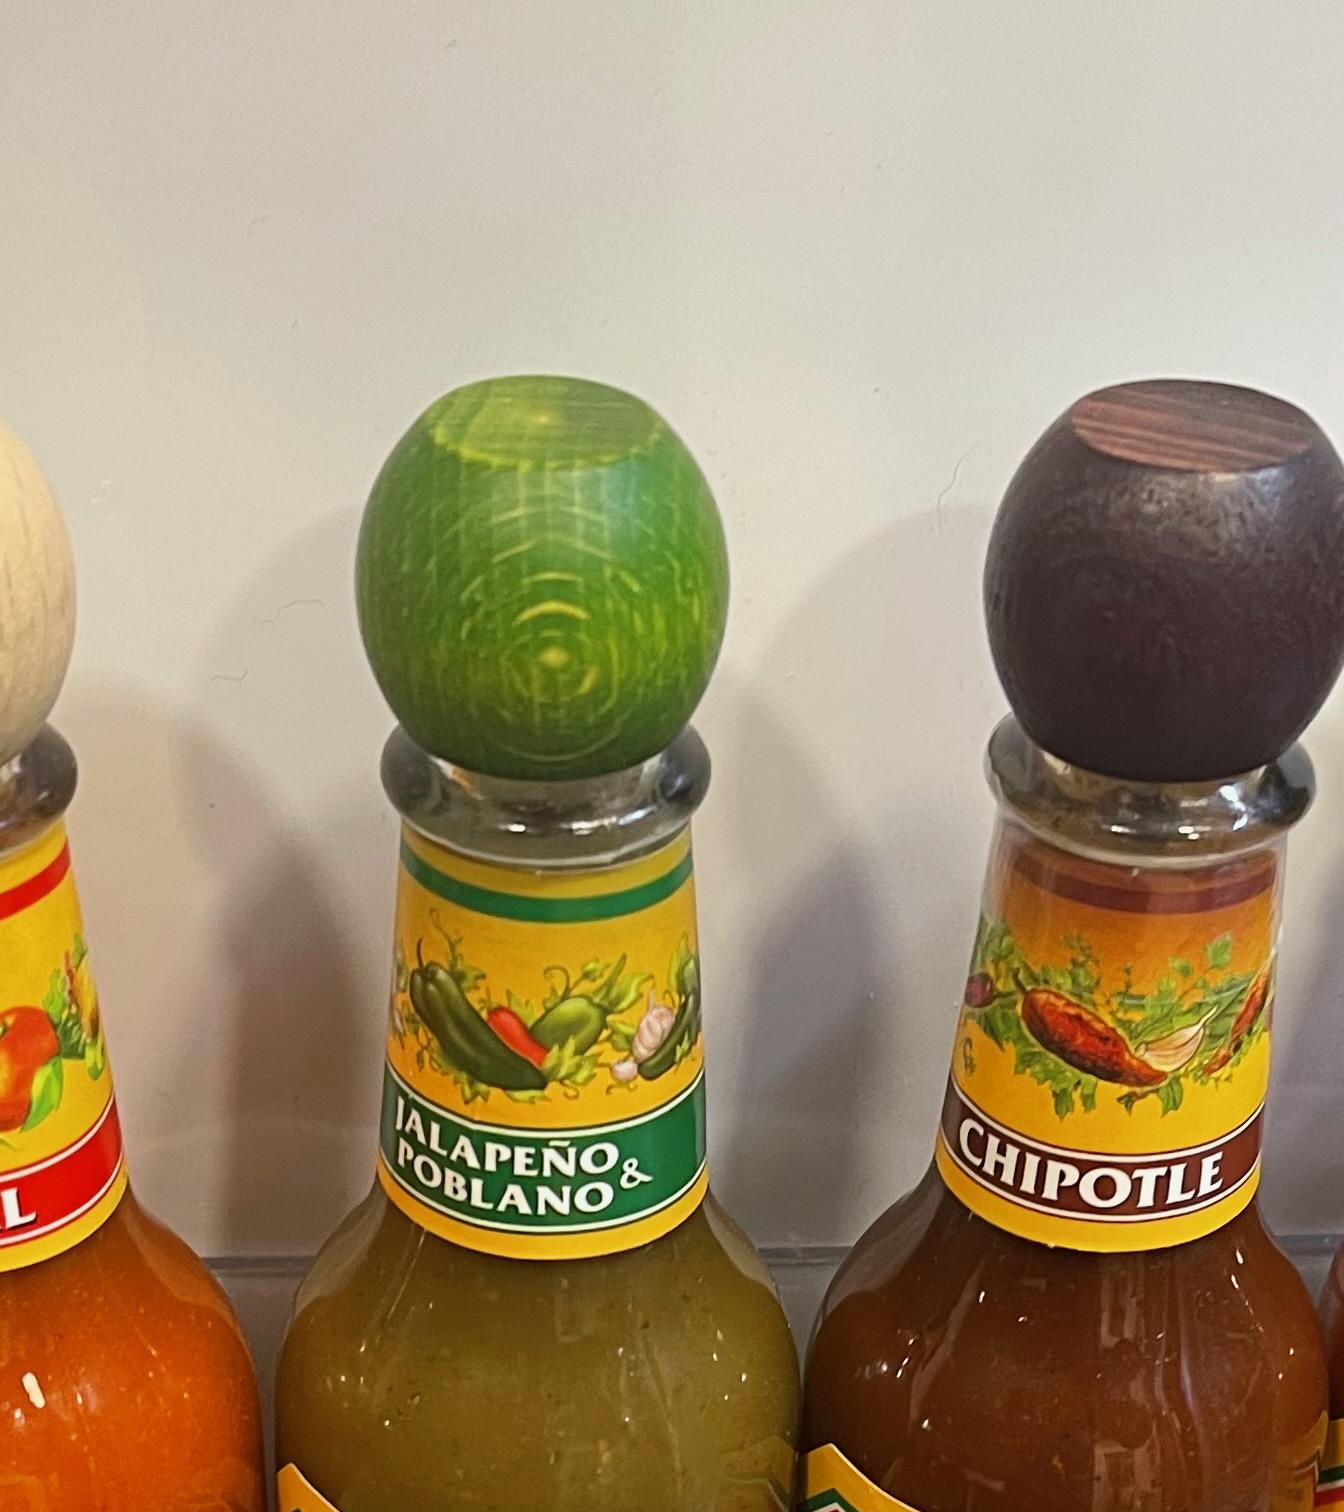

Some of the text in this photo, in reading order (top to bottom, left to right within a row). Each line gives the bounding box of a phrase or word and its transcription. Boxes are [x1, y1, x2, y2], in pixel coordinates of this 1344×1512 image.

[395, 1095, 654, 1191] JALAPEÑO &
[397, 1137, 616, 1216] POBLANO
[958, 1116, 1224, 1209] CHIPOTLE
